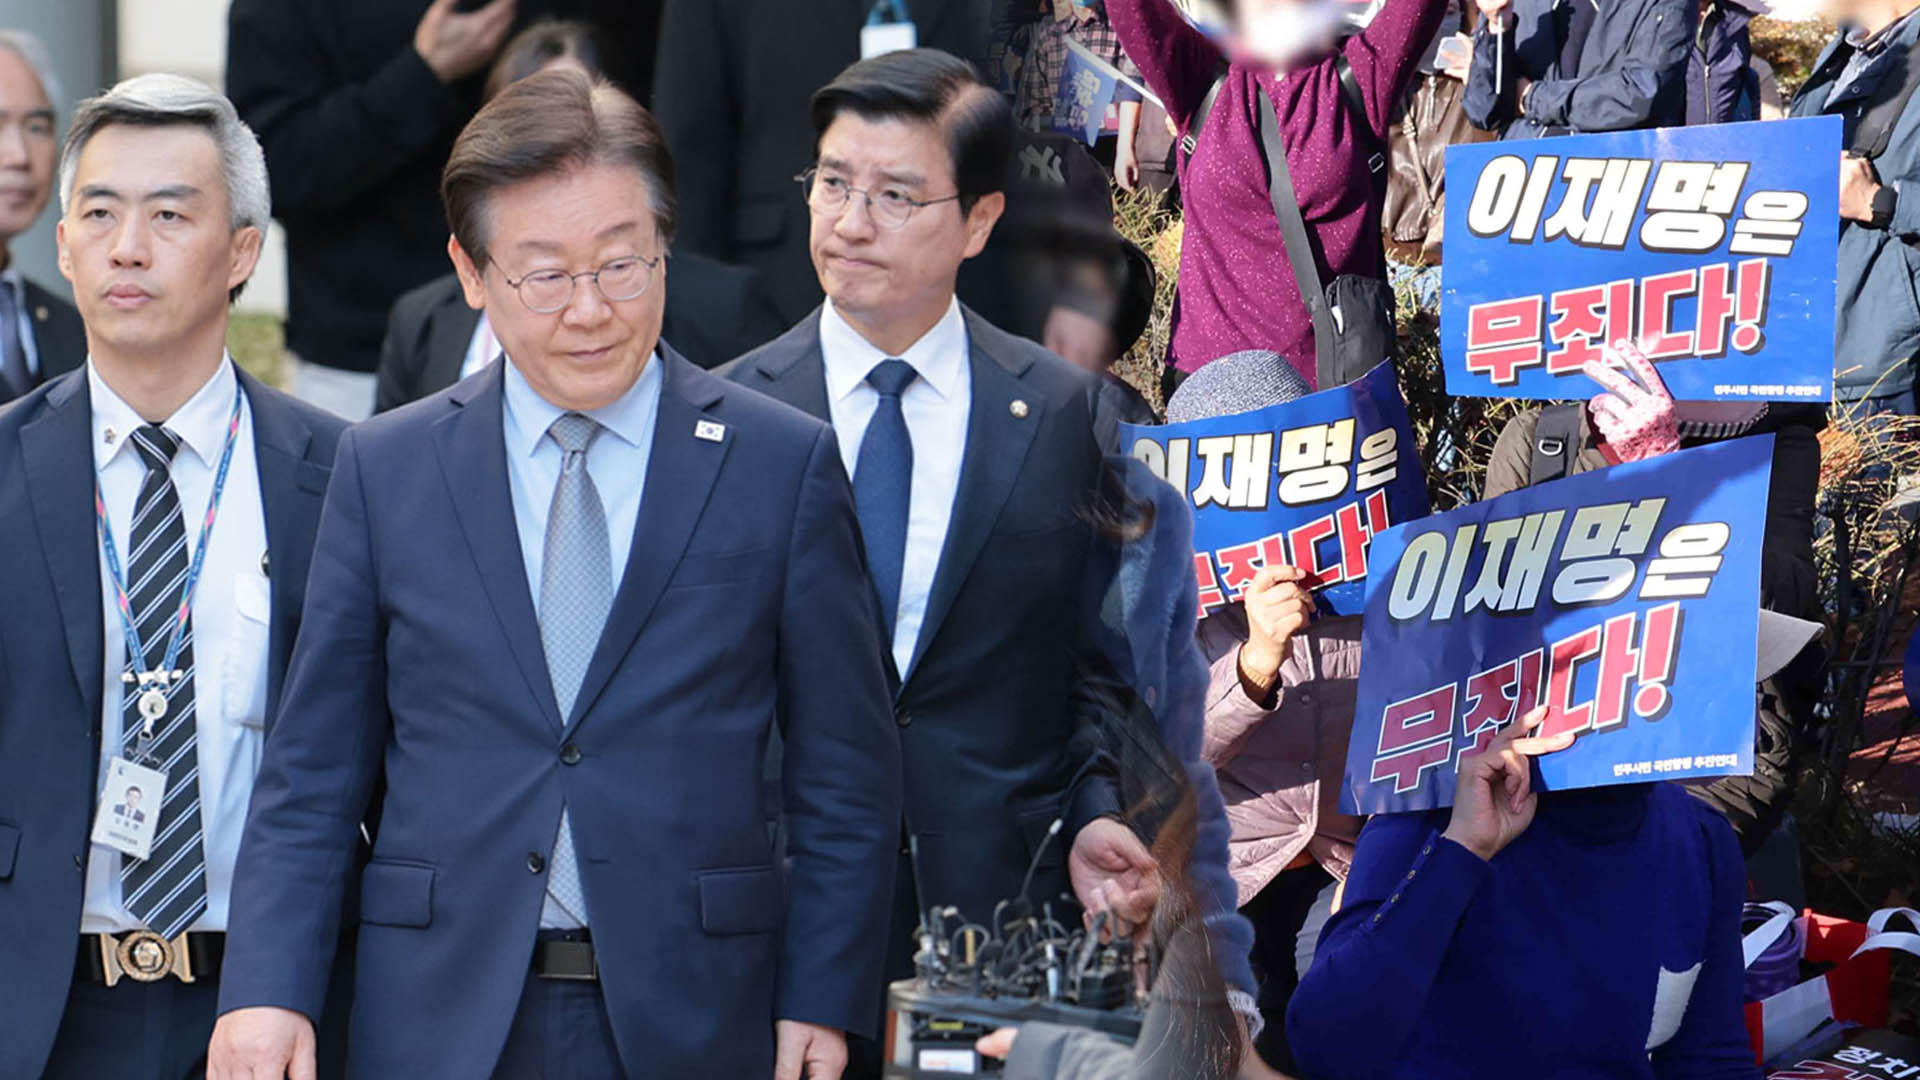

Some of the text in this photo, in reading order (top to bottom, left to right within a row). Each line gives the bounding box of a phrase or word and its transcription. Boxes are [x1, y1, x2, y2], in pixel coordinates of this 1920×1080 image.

[1468, 154, 1809, 256] 이재명은
[1466, 257, 1771, 385] 무죄다!
[1132, 417, 1398, 510] 이재명은
[1388, 497, 1731, 622] 이재명은
[1369, 600, 1681, 794] 무죄다!
[1833, 1045, 1920, 1080] 정치
